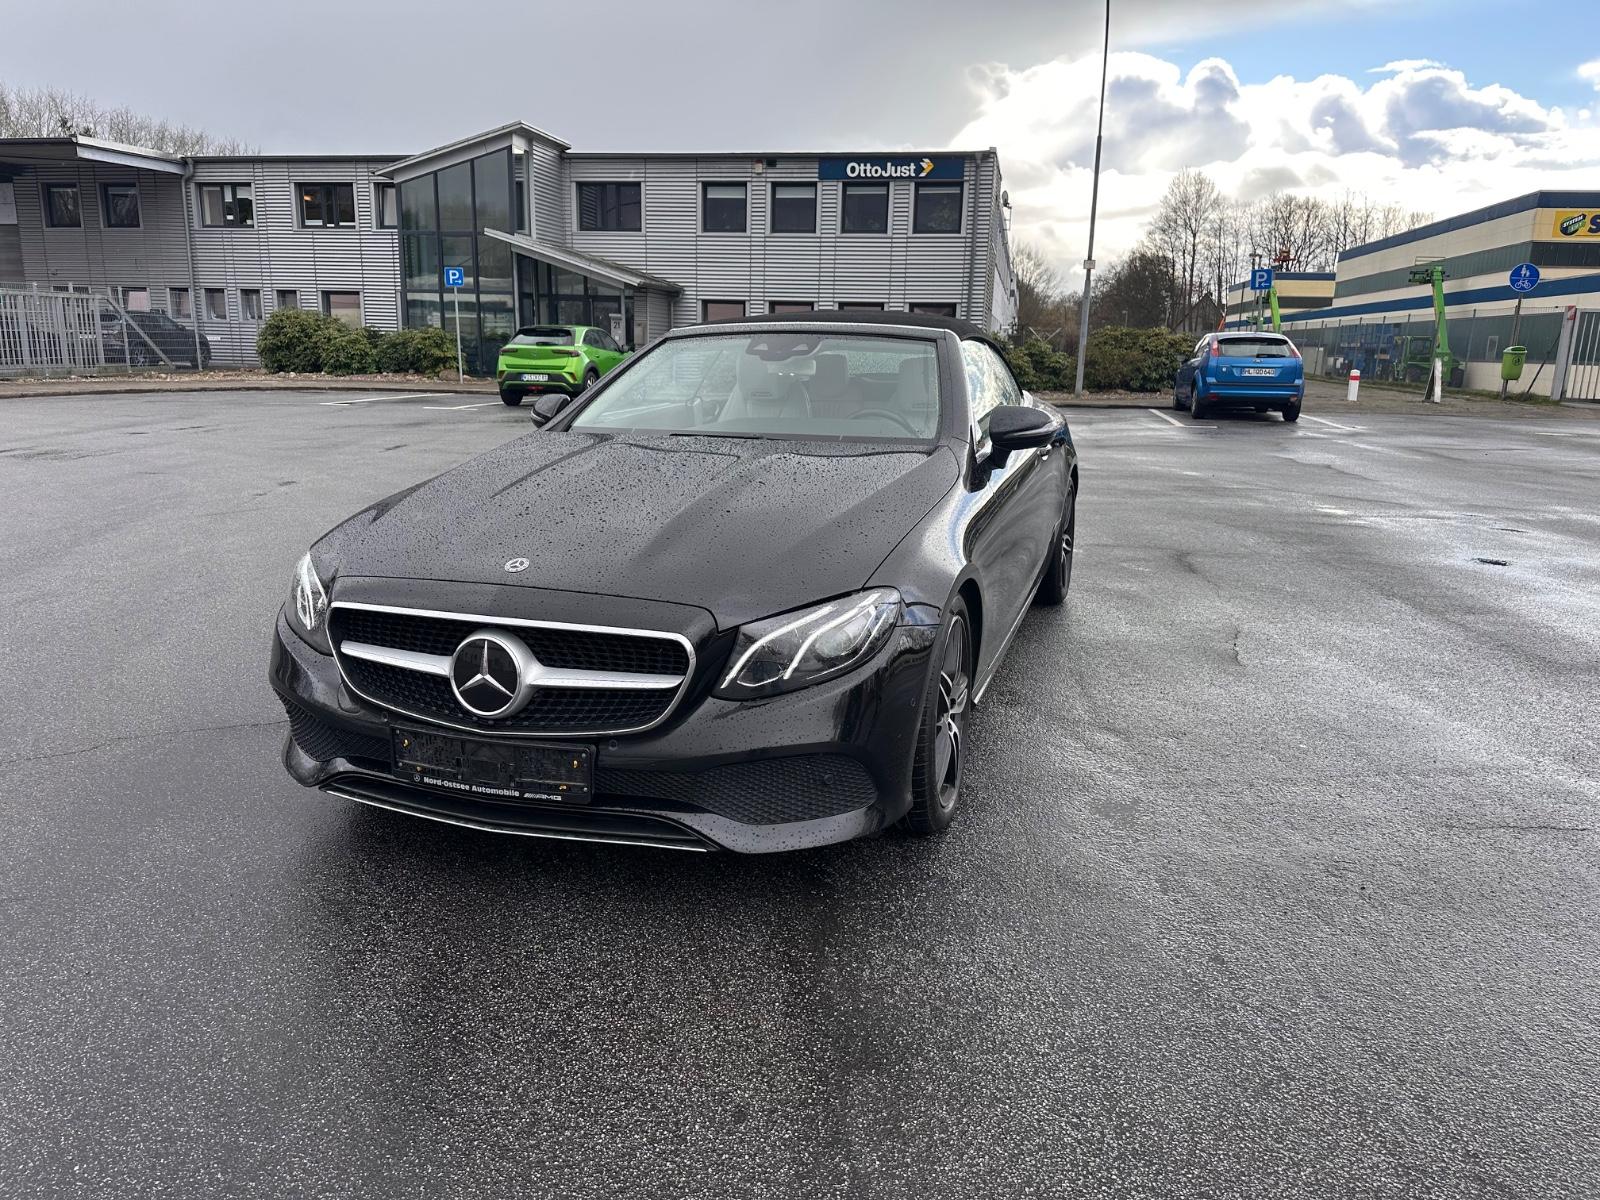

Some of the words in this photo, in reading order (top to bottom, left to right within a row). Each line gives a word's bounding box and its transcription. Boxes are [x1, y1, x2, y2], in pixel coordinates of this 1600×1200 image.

[846, 162, 916, 178] OttoJust
[449, 270, 459, 284] P
[1255, 271, 1268, 288] P
[471, 785, 520, 797] Automobile
